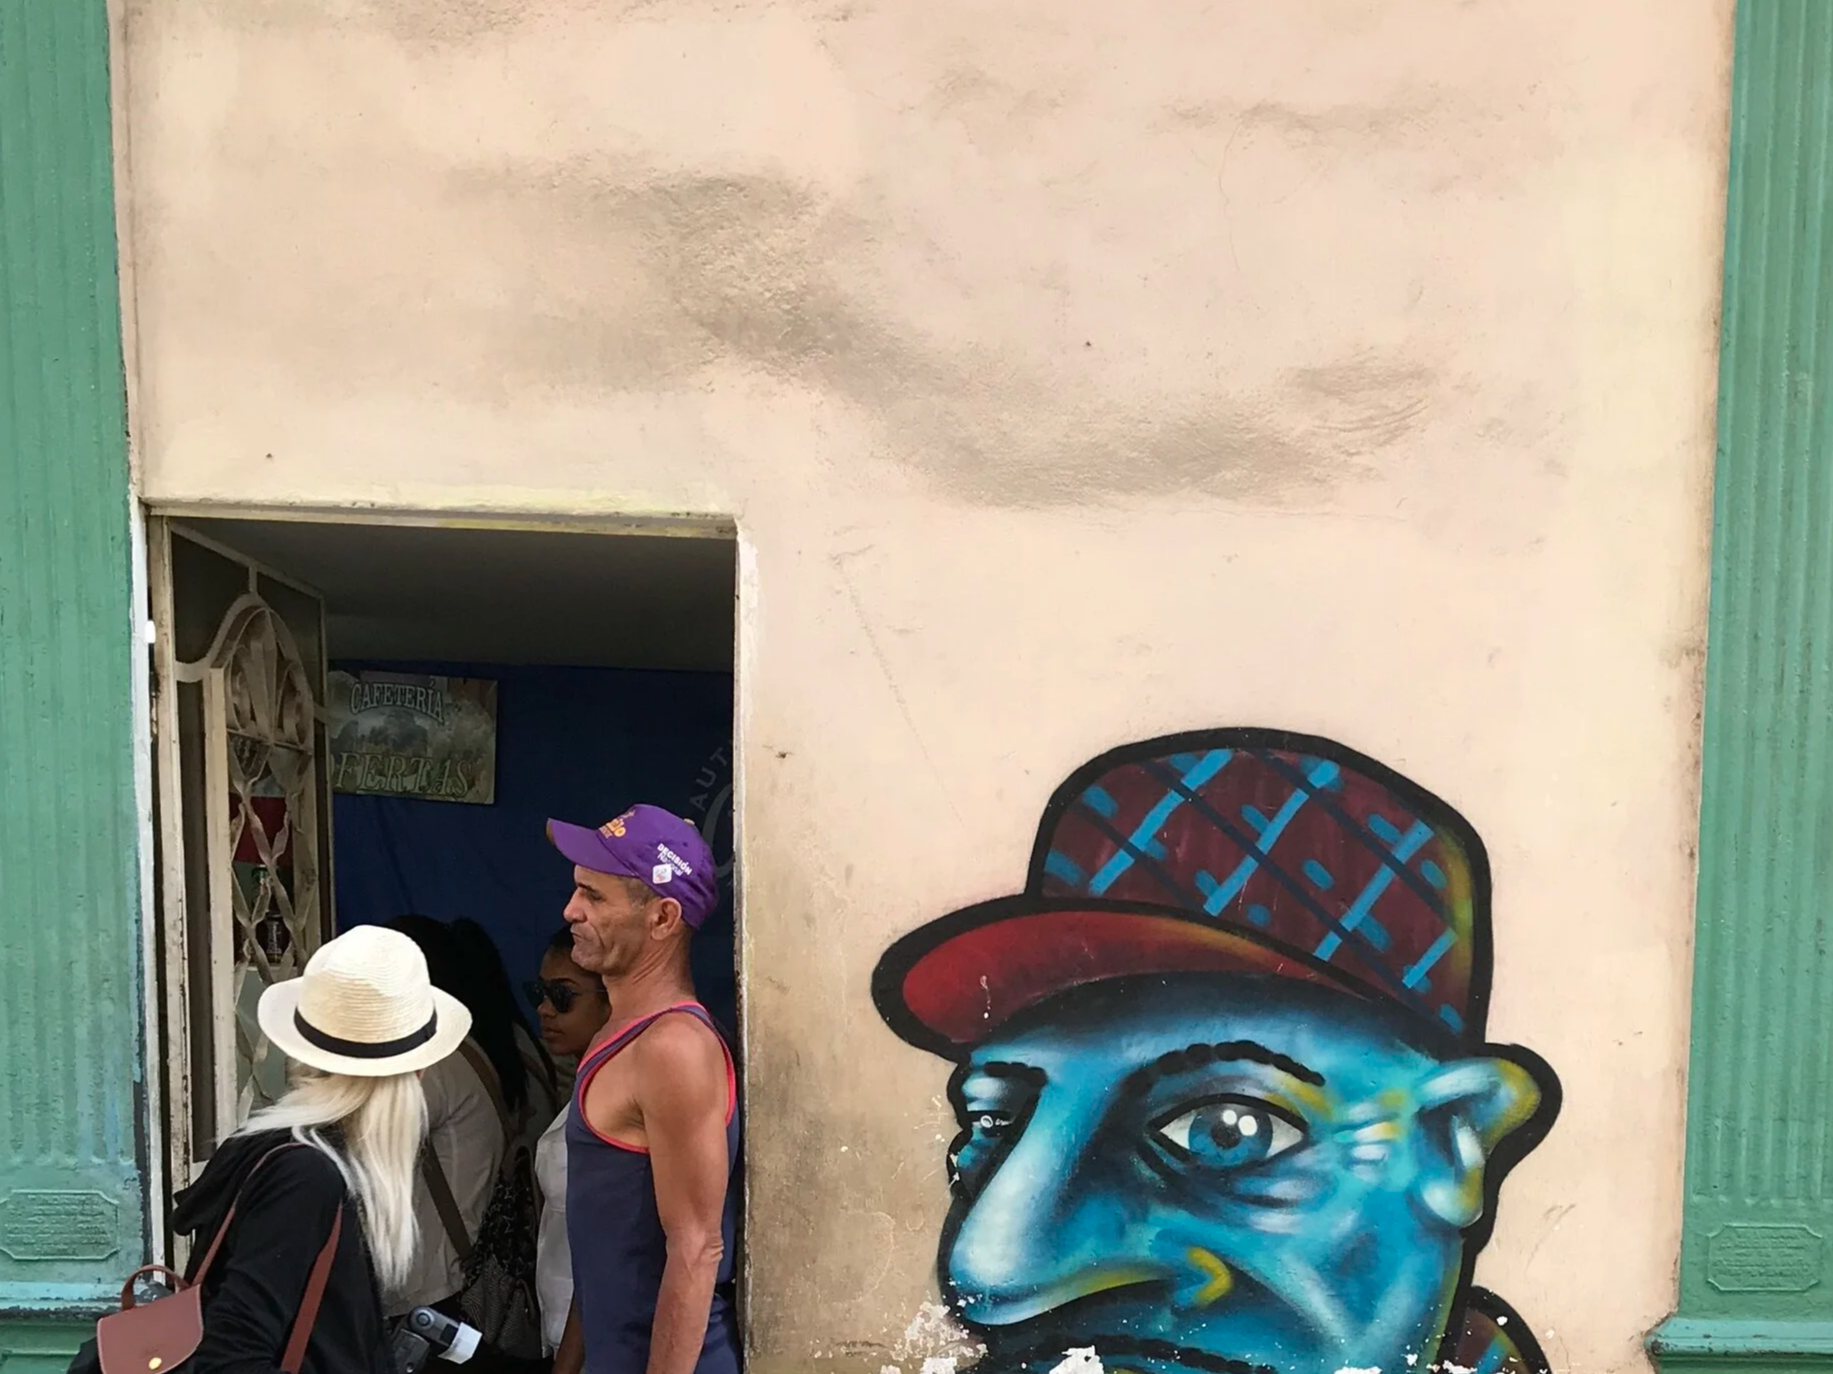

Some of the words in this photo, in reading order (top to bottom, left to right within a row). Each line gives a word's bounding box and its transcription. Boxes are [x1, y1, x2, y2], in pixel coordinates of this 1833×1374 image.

[351, 680, 444, 725] CAFETERÍA
[329, 752, 472, 797] FERTAS
[690, 741, 733, 811] AUT
[657, 843, 693, 876] DECISIÓN
